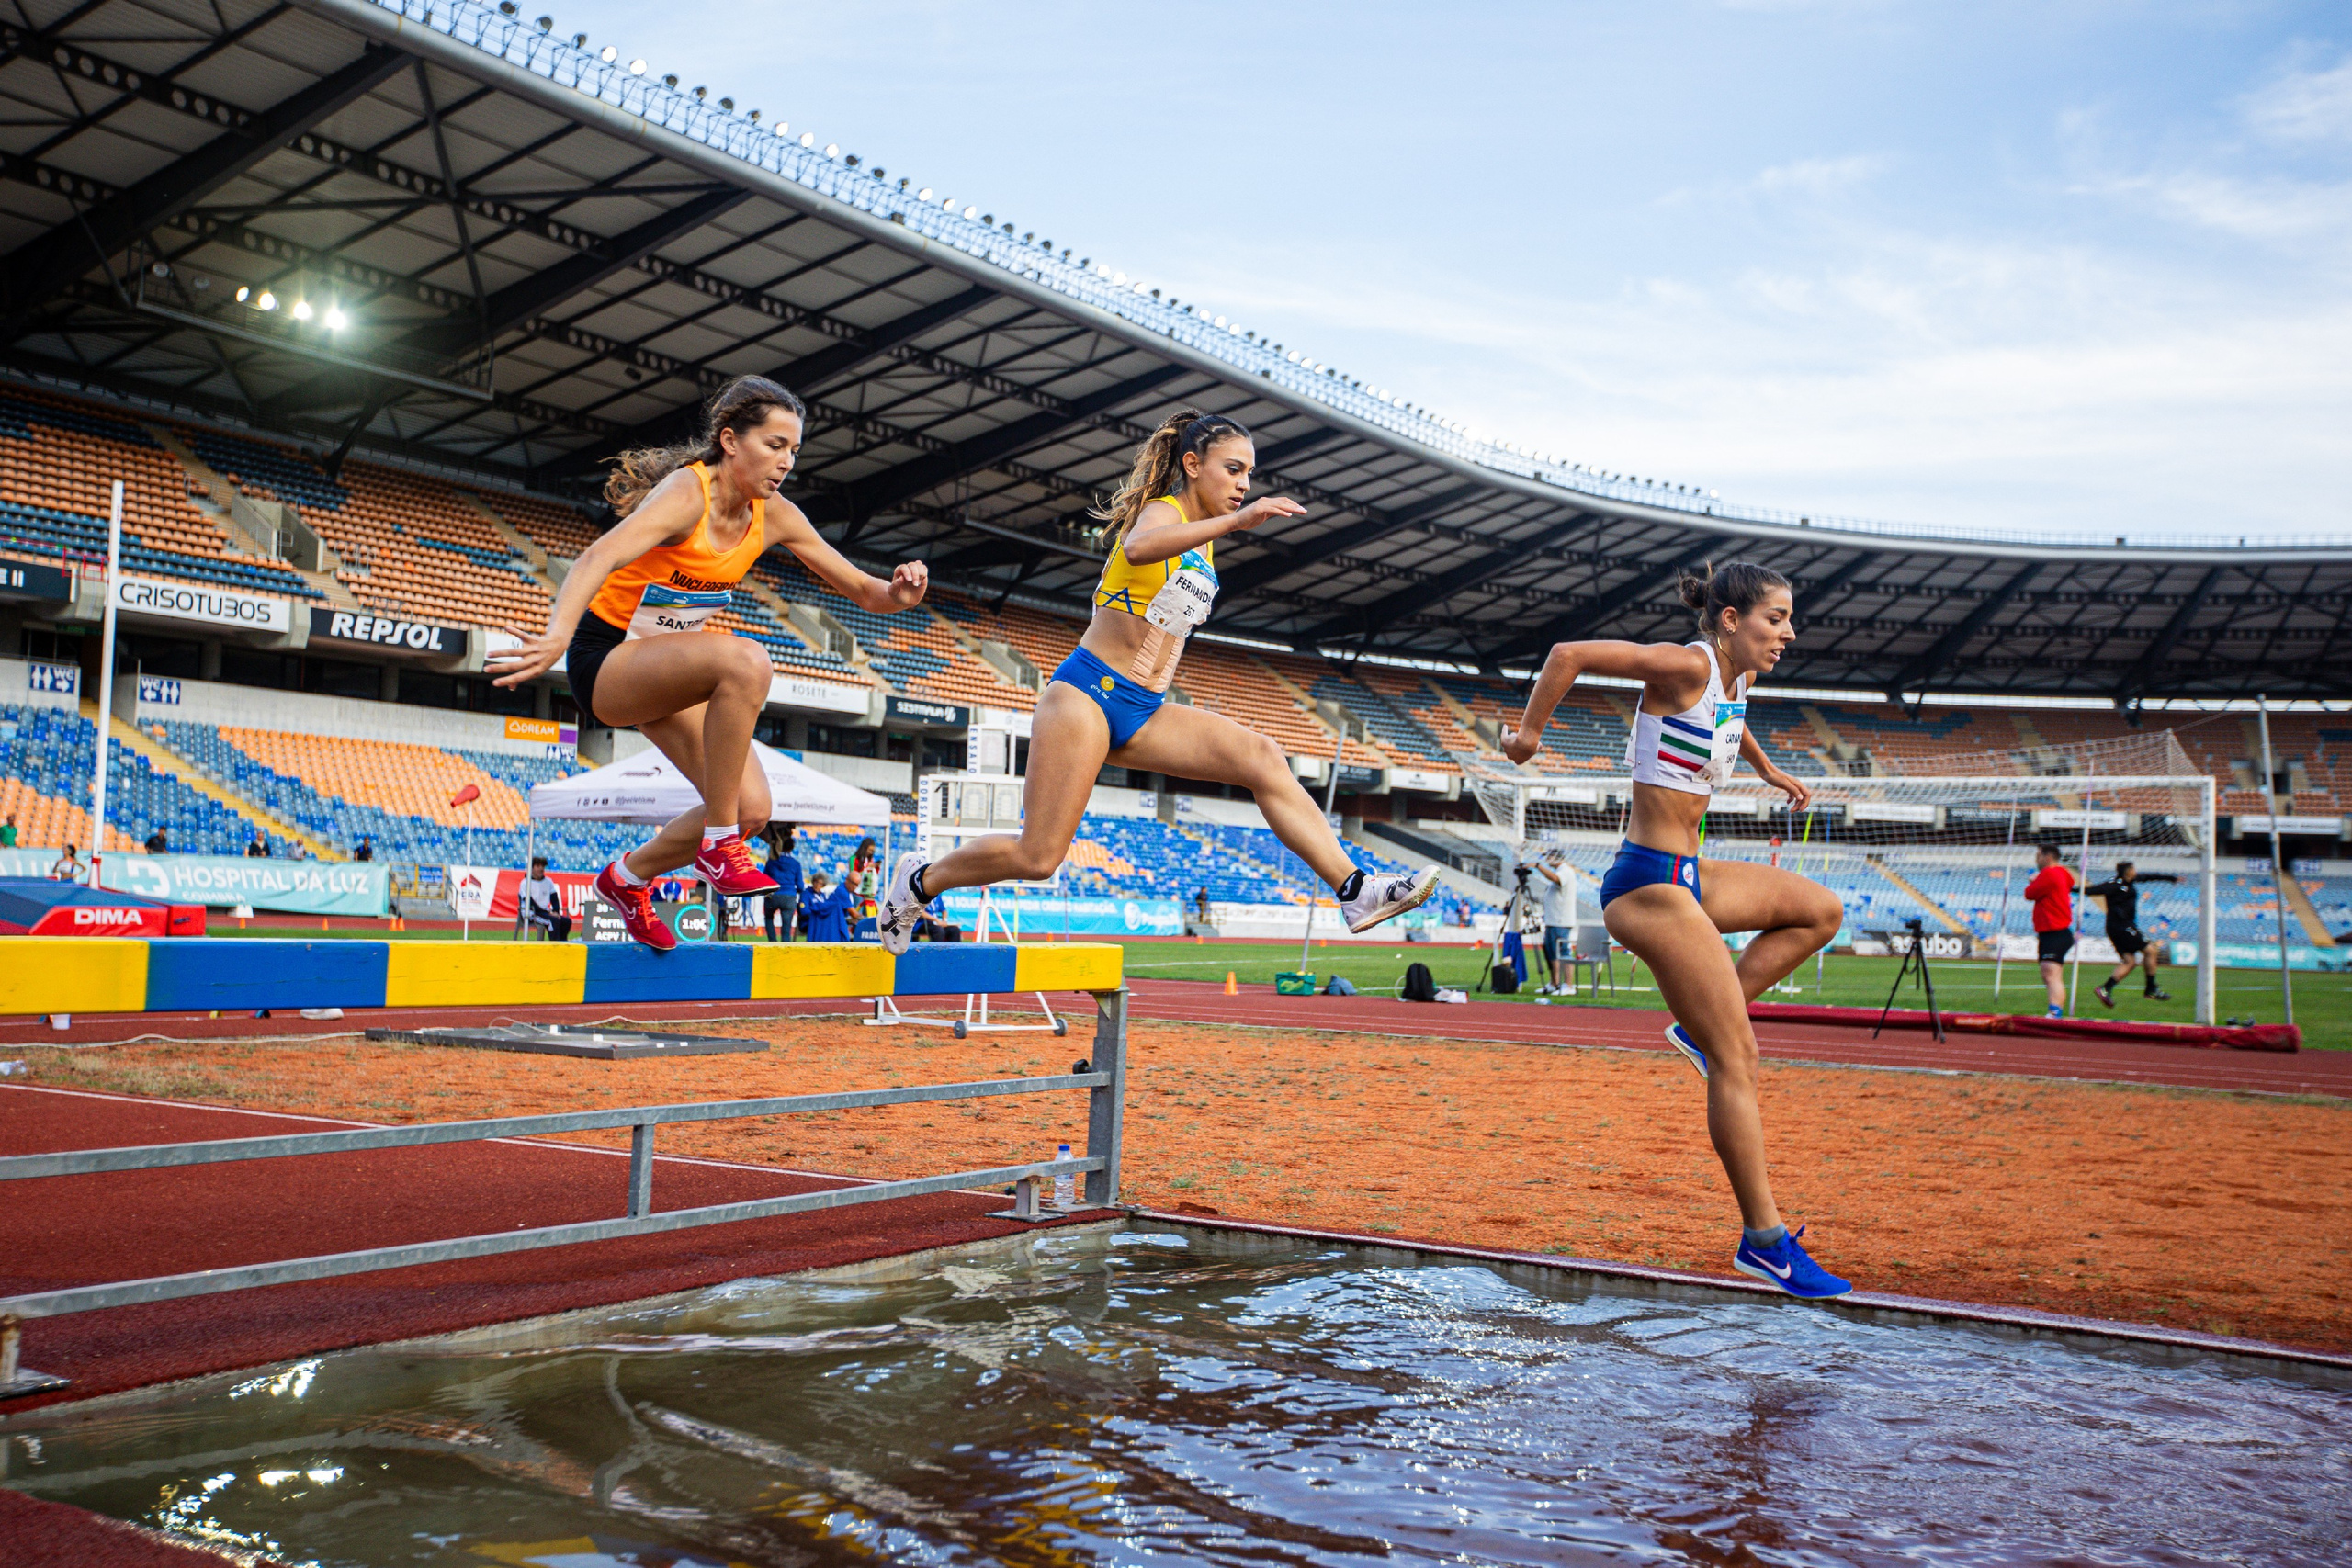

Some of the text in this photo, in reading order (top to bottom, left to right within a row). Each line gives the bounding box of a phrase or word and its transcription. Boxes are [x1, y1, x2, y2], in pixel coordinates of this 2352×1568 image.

[330, 612, 443, 651] REPSOL
[53, 667, 74, 681] WC
[141, 678, 160, 689] WC
[792, 683, 827, 699] ROSETE
[521, 723, 555, 735] DREAM
[968, 728, 978, 773] ENSAIO
[919, 780, 928, 826] DORSAL
[174, 864, 369, 895] HOSPITAL DA LUZ
[74, 908, 143, 925] DIMA
